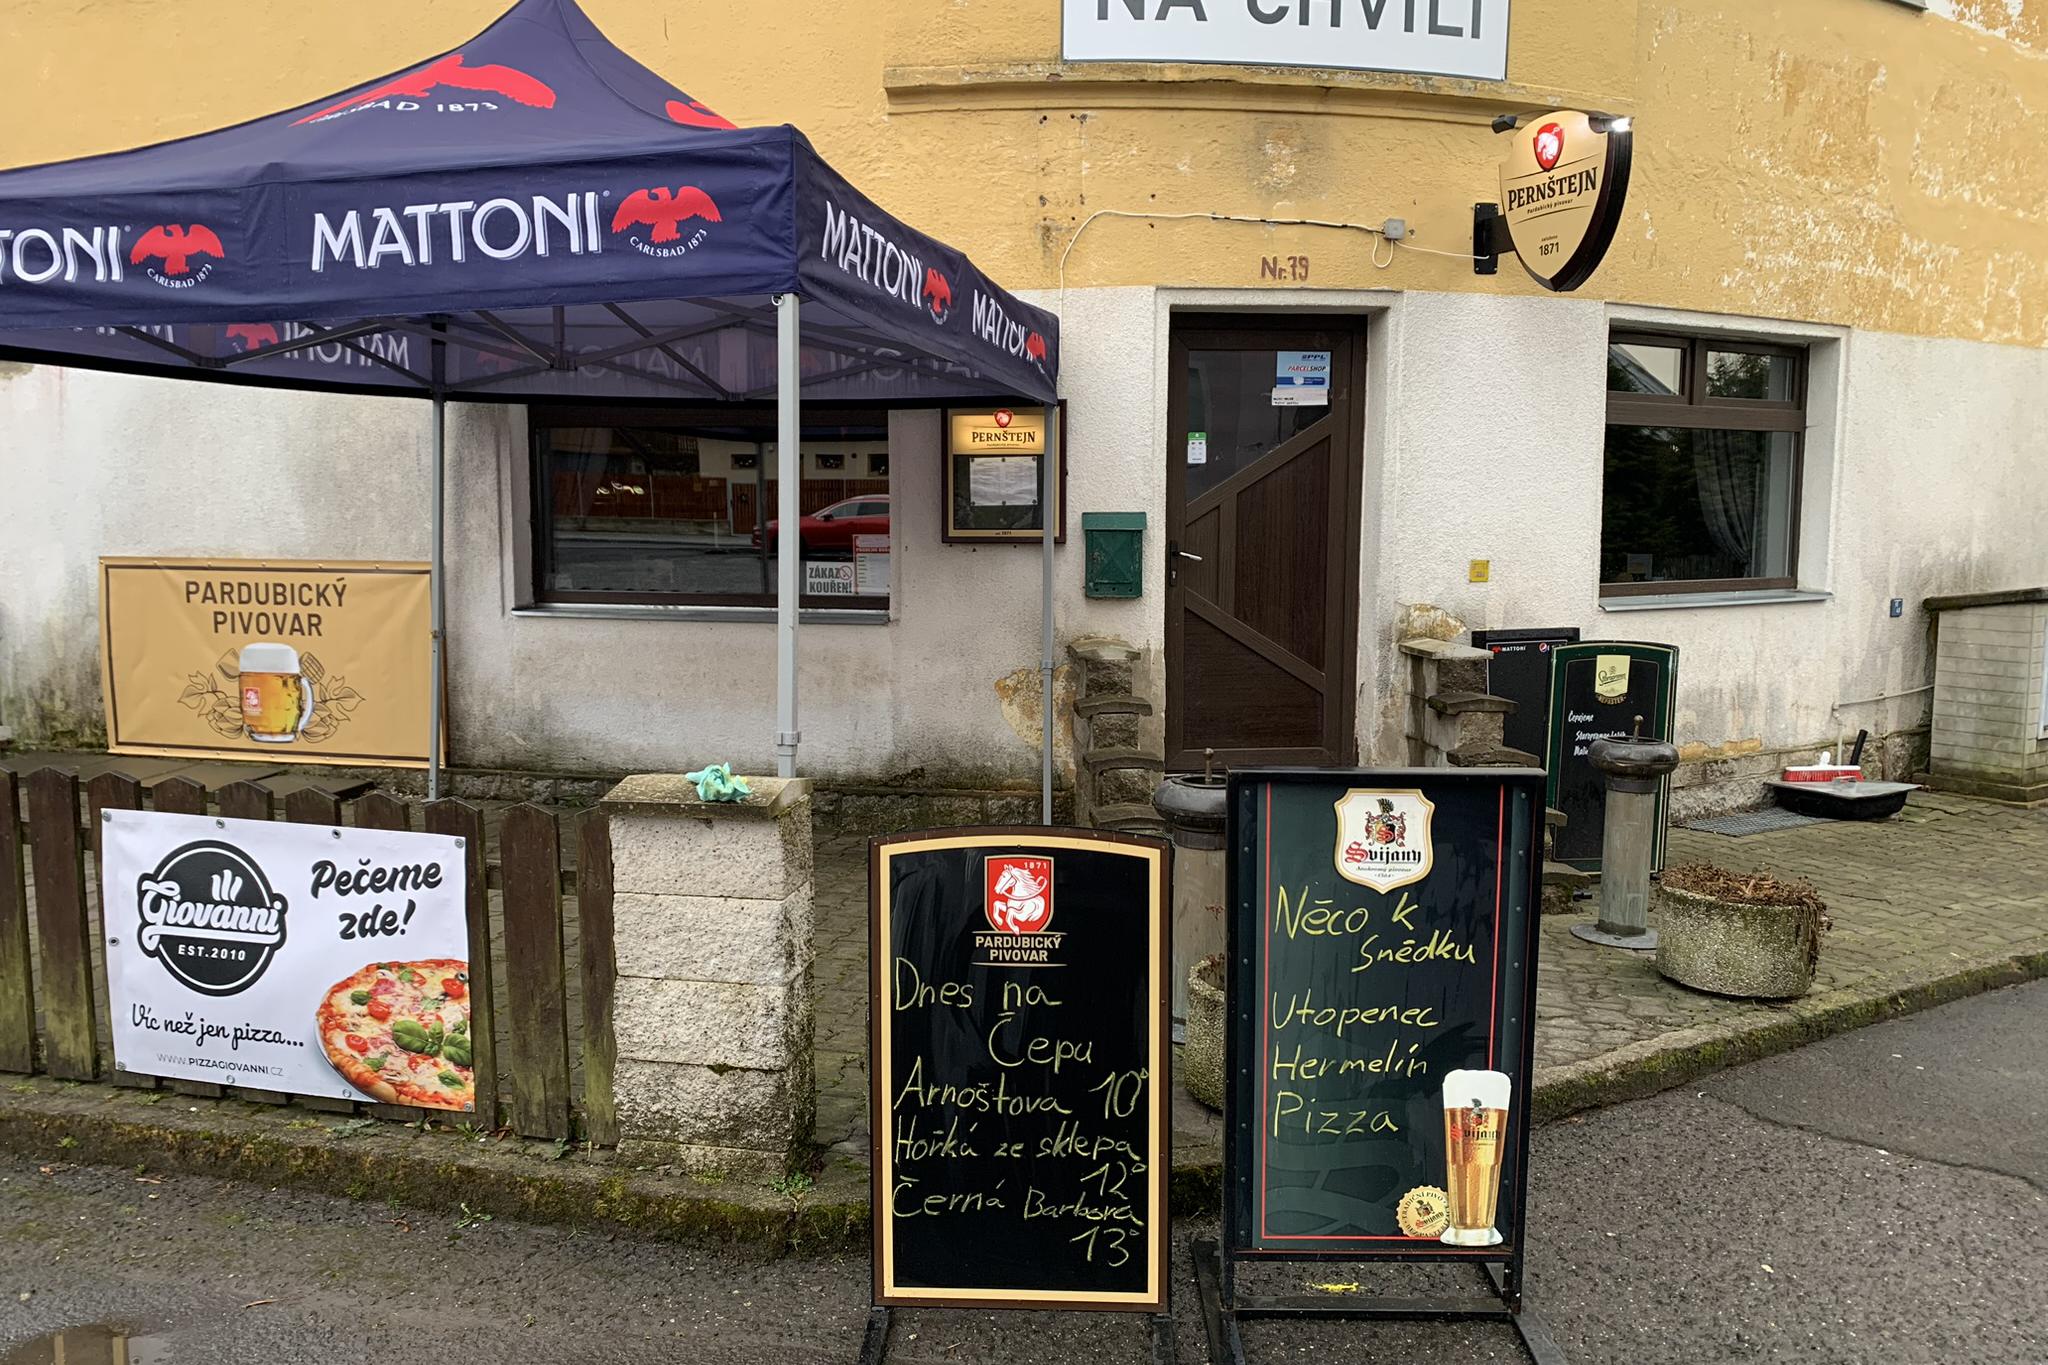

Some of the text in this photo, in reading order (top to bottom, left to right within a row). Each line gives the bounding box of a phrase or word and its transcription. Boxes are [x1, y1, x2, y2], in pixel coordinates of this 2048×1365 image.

[436, 101, 498, 112] 1873
[1507, 166, 1599, 211] PERNŠTEJN
[311, 191, 602, 273] MATTONI
[629, 228, 708, 257] CARLSBAD 1873
[1539, 242, 1559, 256] 1871
[146, 263, 213, 289] CARLSBAD 1873
[821, 200, 923, 310] MATTONI
[971, 430, 1036, 444] PERNŠTEJN
[185, 576, 348, 608] PARDUBICKÝ
[808, 564, 840, 579] ZÁKAZ
[213, 611, 323, 637] PIVOVAR
[1023, 861, 1048, 870] 1871
[1344, 841, 1422, 865] Svijany
[310, 857, 443, 899] Pečeme
[141, 880, 283, 951] Giovanni
[338, 898, 417, 940] zde!
[1274, 884, 1370, 940] Něco
[975, 934, 1062, 950] PARDUBICKÝ
[989, 949, 1048, 962] PIVOVAR
[895, 957, 1063, 1011] Dnes na
[131, 1003, 304, 1051] Víc než jen pizza...
[1272, 988, 1440, 1037] Utopenec
[988, 1011, 1092, 1074] Čepu
[1272, 1039, 1428, 1081] Hermelín
[157, 1053, 284, 1077] WWW.PIZZAGIOVANNI.CZ
[894, 1055, 1073, 1116] Arnoštova
[1273, 1089, 1399, 1138] Pizza
[993, 1142, 1025, 1158] ze
[1036, 1120, 1141, 1161] sklepa
[892, 1175, 1006, 1218] Černá
